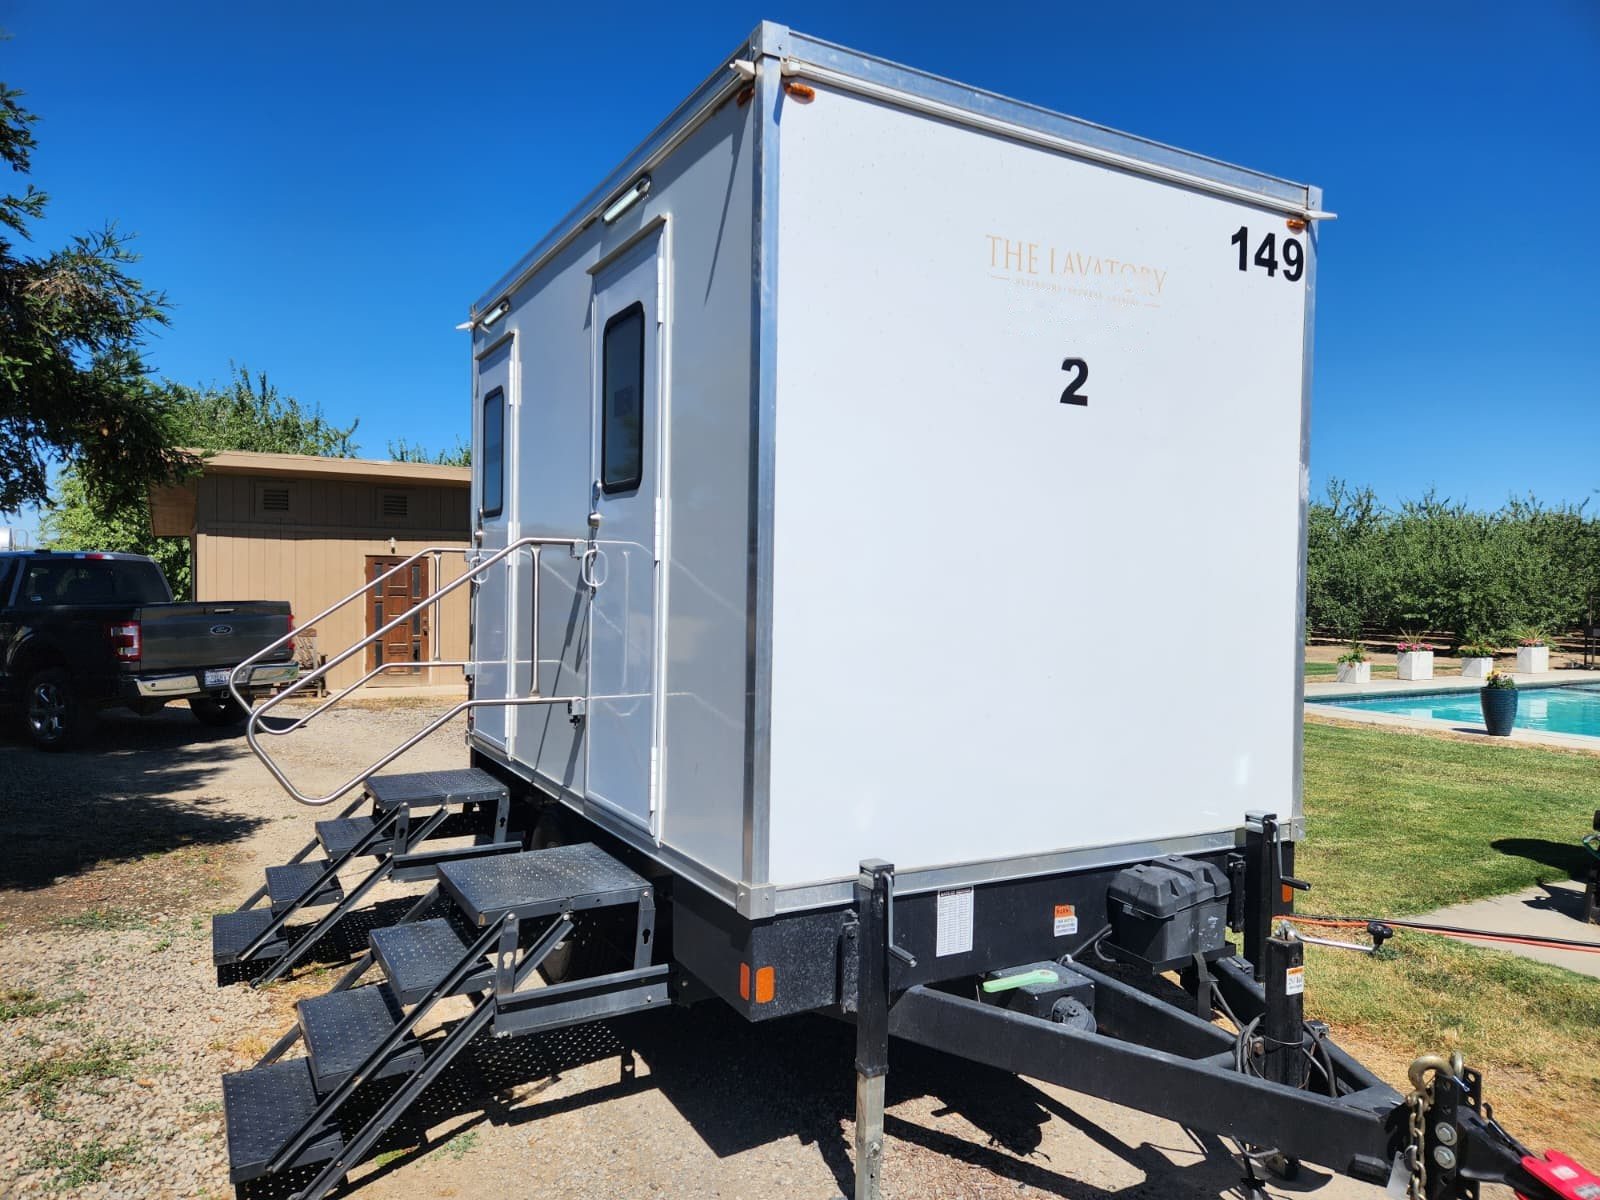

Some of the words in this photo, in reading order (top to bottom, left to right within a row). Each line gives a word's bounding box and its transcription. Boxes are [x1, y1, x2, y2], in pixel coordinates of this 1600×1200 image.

[986, 234, 1039, 274] THE
[1231, 226, 1304, 282] 149
[1060, 357, 1089, 407] 2
